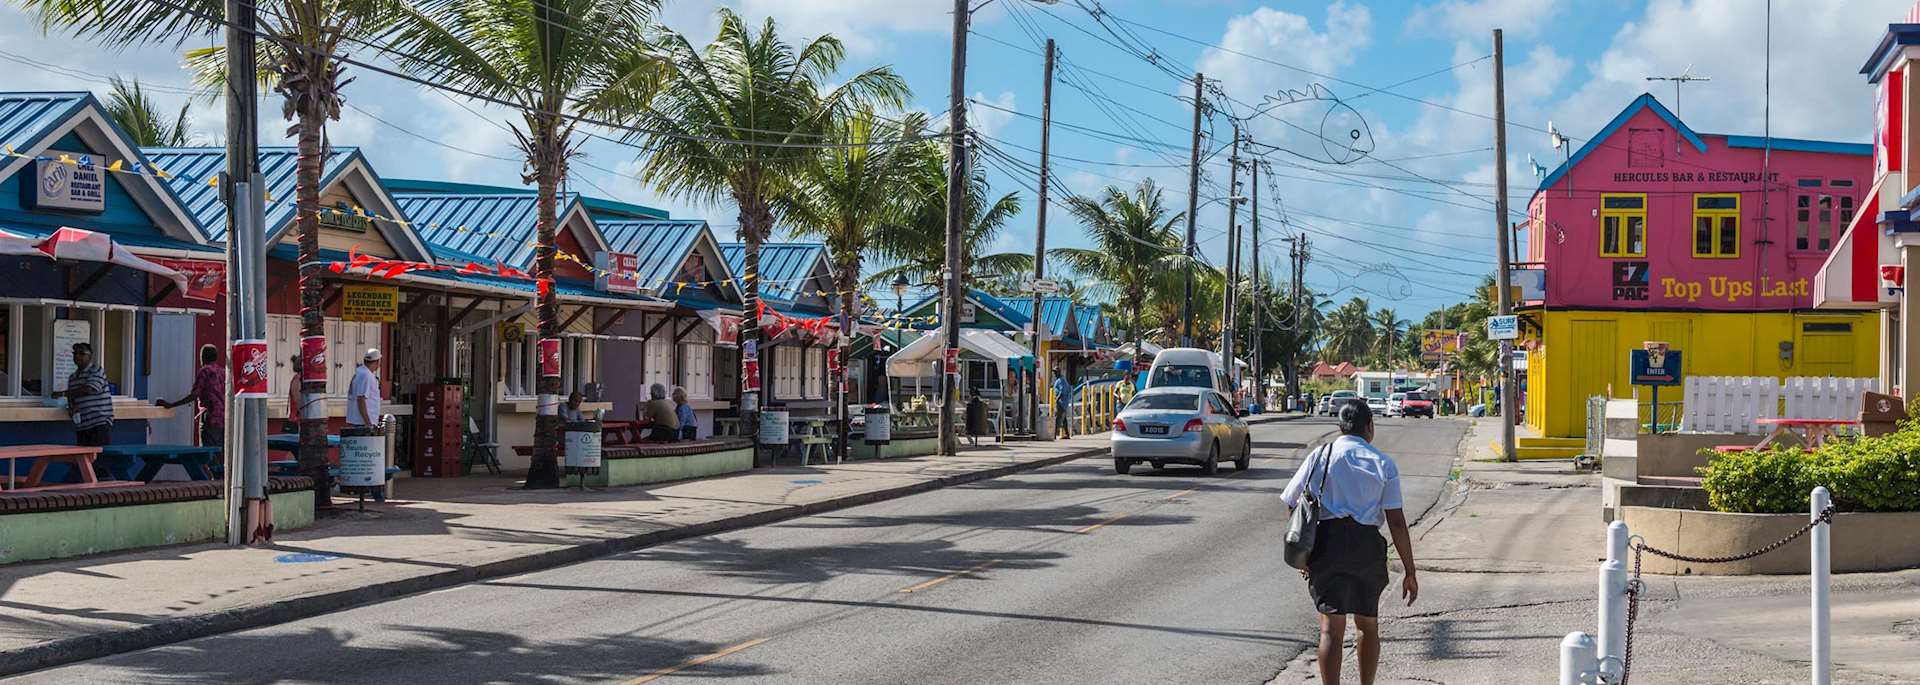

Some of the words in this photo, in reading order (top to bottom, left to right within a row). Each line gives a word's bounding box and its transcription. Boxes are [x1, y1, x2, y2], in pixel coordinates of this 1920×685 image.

[73, 171, 99, 182] DANIEL
[1614, 172, 1669, 182] HERCULES
[1672, 172, 1694, 182] BAR
[1697, 172, 1705, 182] &
[1661, 278, 1702, 302] Top
[1709, 277, 1753, 302] Ups
[1760, 276, 1809, 297] Last
[347, 291, 392, 300] LEGENDARY
[1612, 287, 1648, 301] PAC
[347, 299, 392, 308] FISHCAKES
[1646, 367, 1665, 375] ENTER
[354, 450, 382, 459] Recycle
